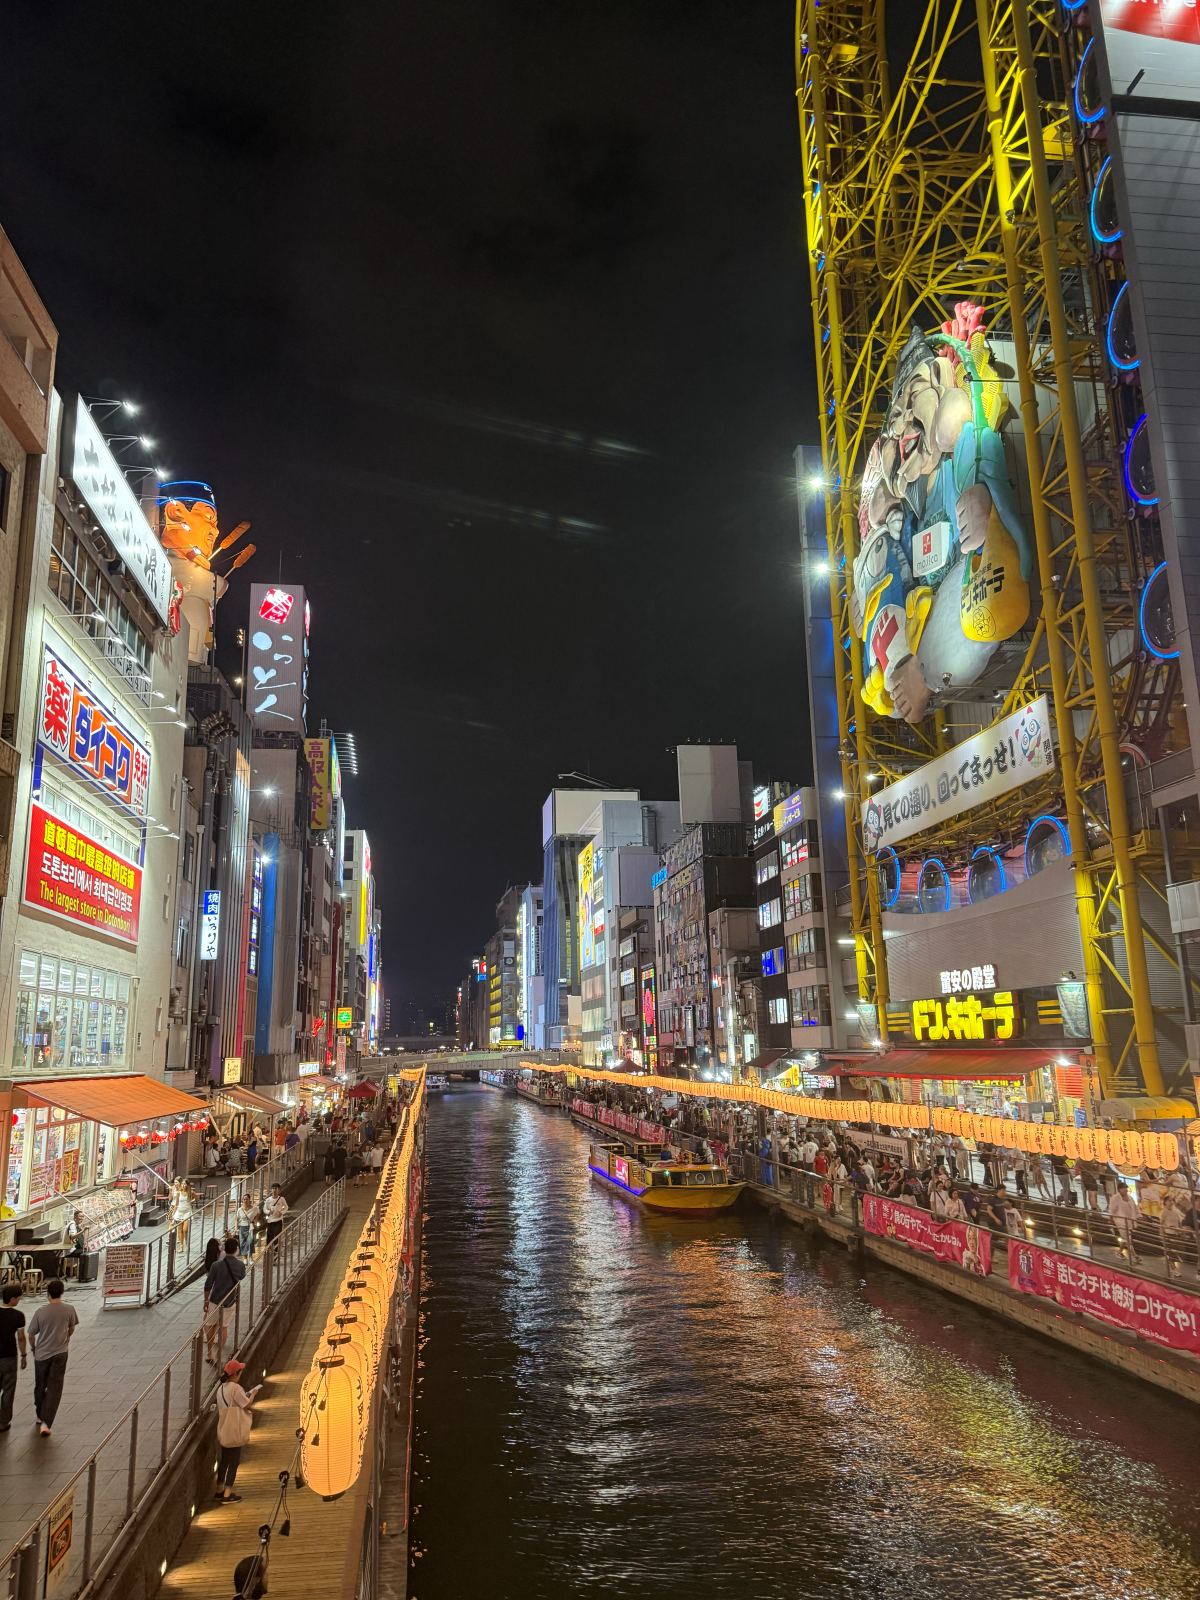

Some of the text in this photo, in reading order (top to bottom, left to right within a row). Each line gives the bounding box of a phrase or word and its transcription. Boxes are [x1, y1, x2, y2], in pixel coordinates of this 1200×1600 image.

[44, 659, 71, 751] 薬
[74, 702, 131, 796] ダイコク
[134, 748, 148, 790] 免税
[41, 851, 93, 896] 도톤보리에서
[40, 880, 54, 903] The
[55, 886, 80, 914] largest
[80, 901, 97, 919] store
[97, 905, 103, 922] in
[207, 892, 219, 914] 焼肉
[940, 964, 996, 994] 驚安の殿堂
